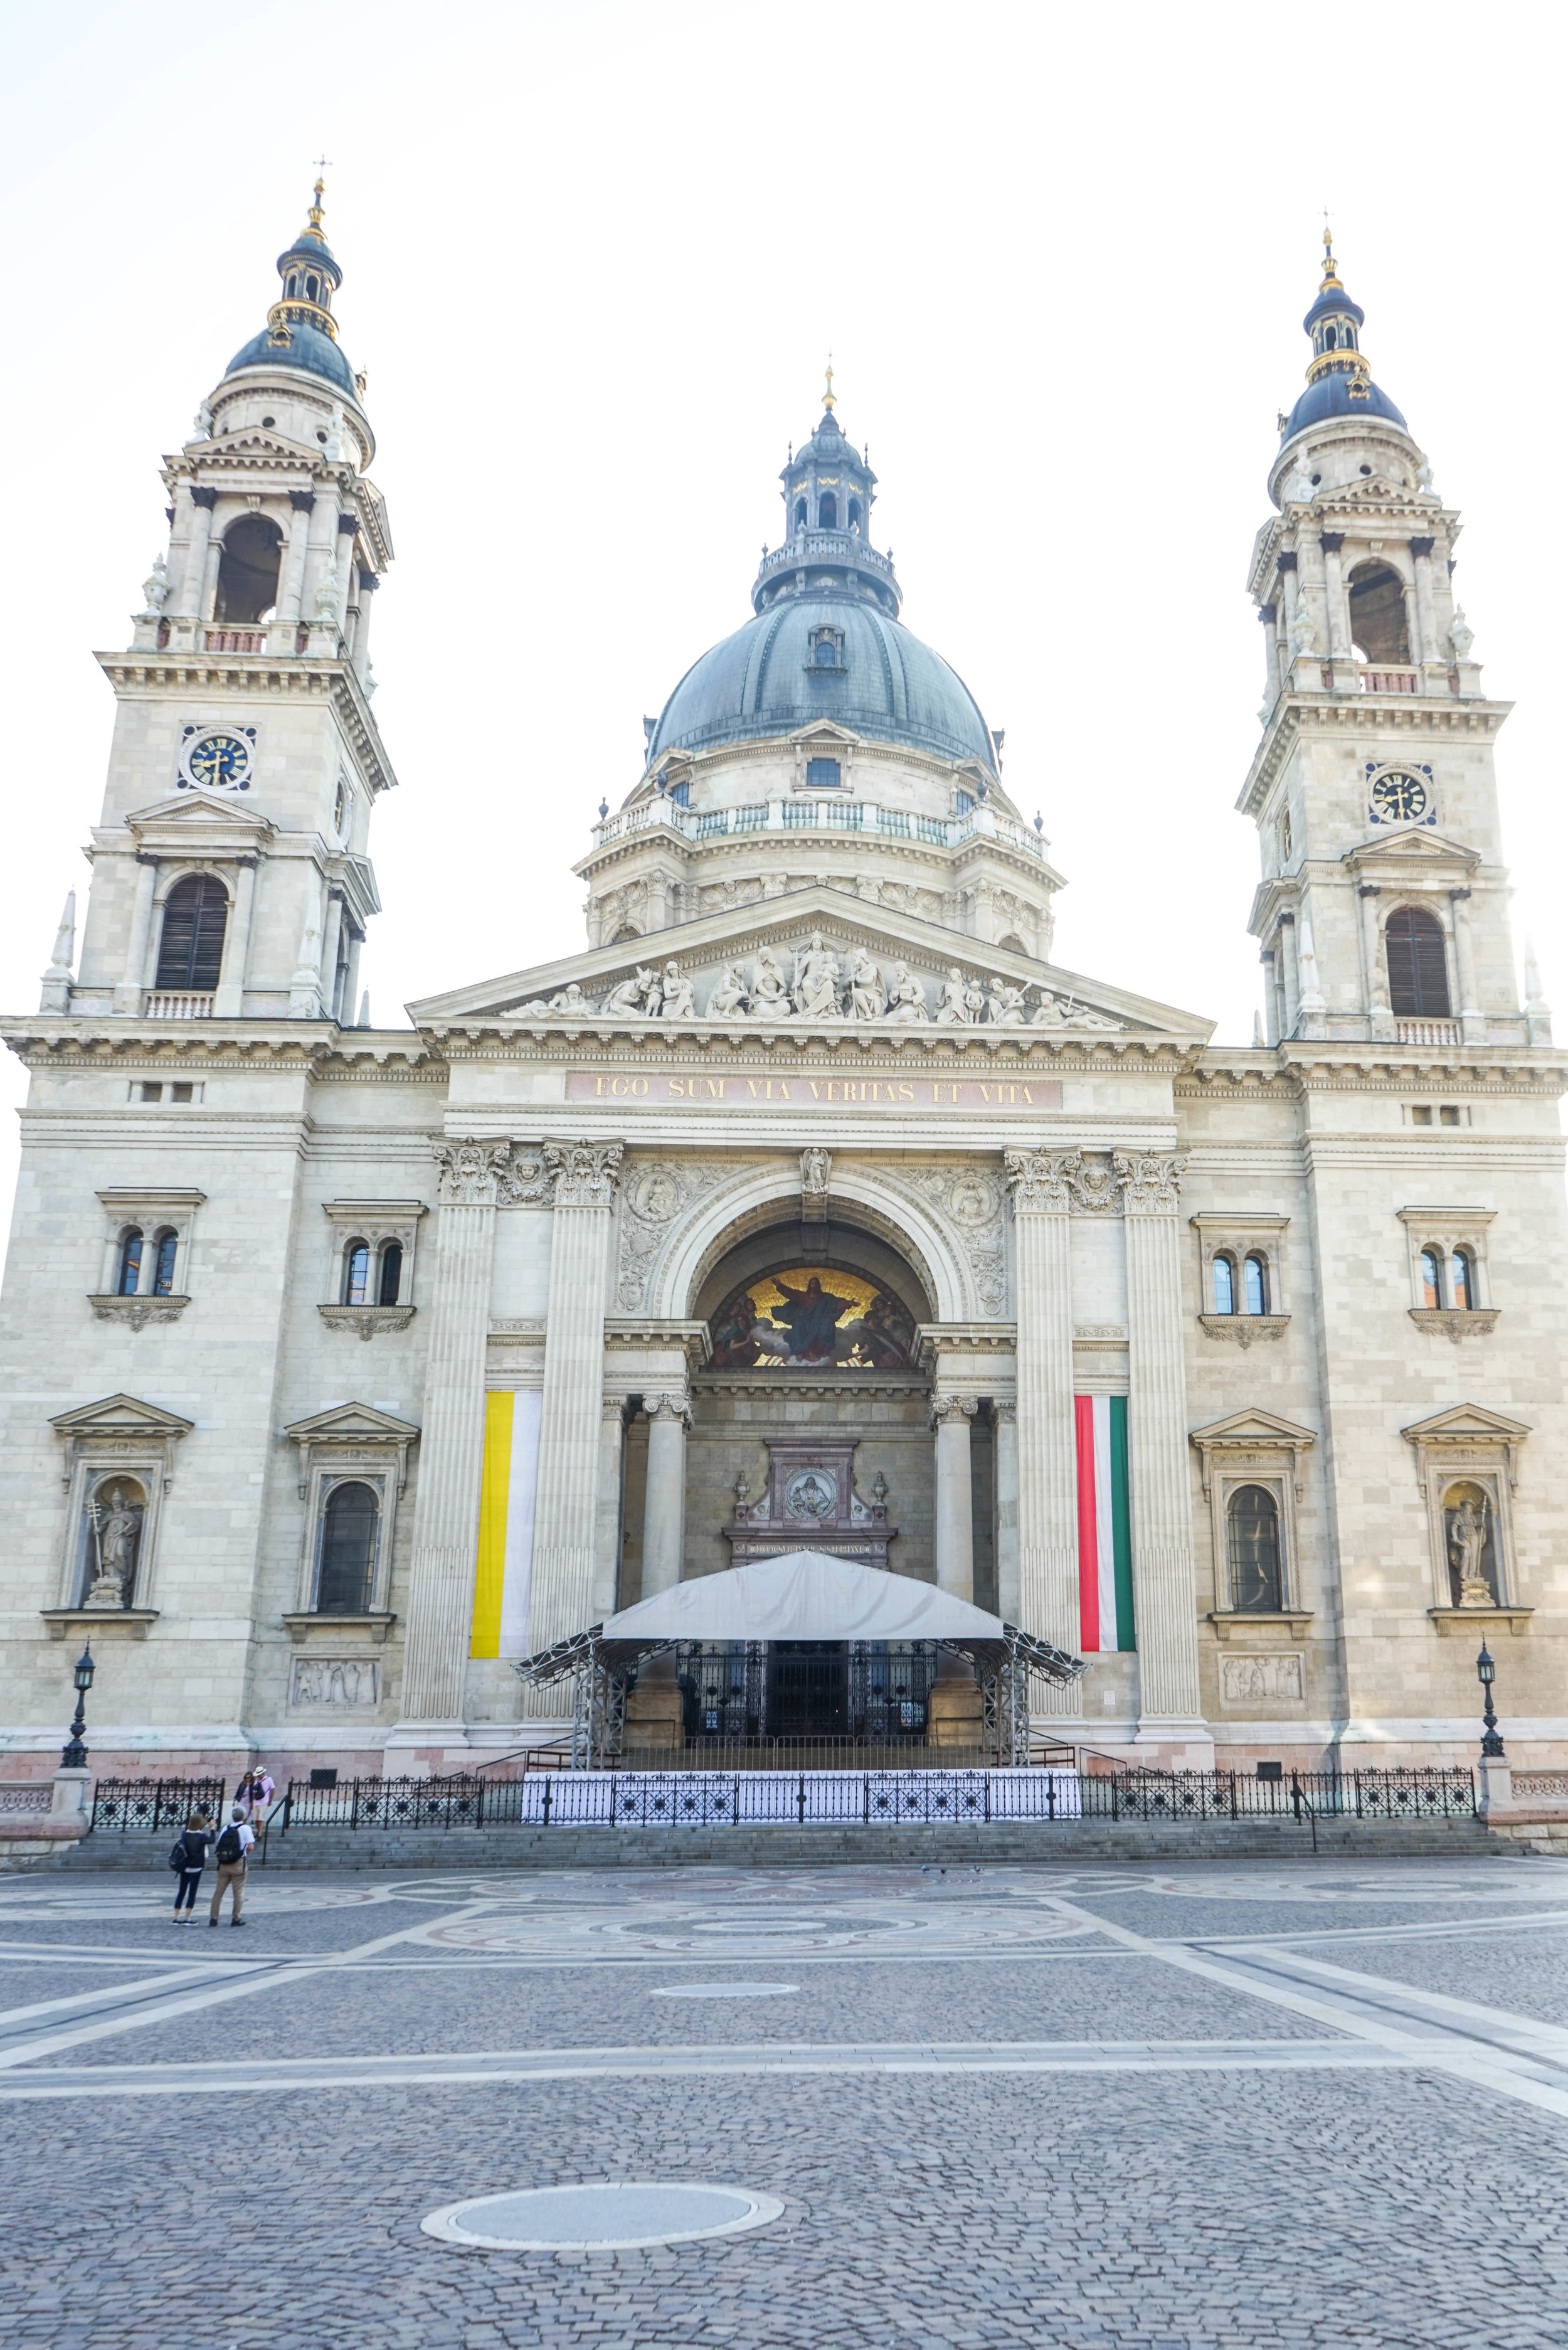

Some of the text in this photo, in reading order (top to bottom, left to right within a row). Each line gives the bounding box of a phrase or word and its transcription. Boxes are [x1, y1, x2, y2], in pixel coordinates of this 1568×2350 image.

[595, 1077, 1035, 1104] EGO SUM VIA VERITAS ET VITA
